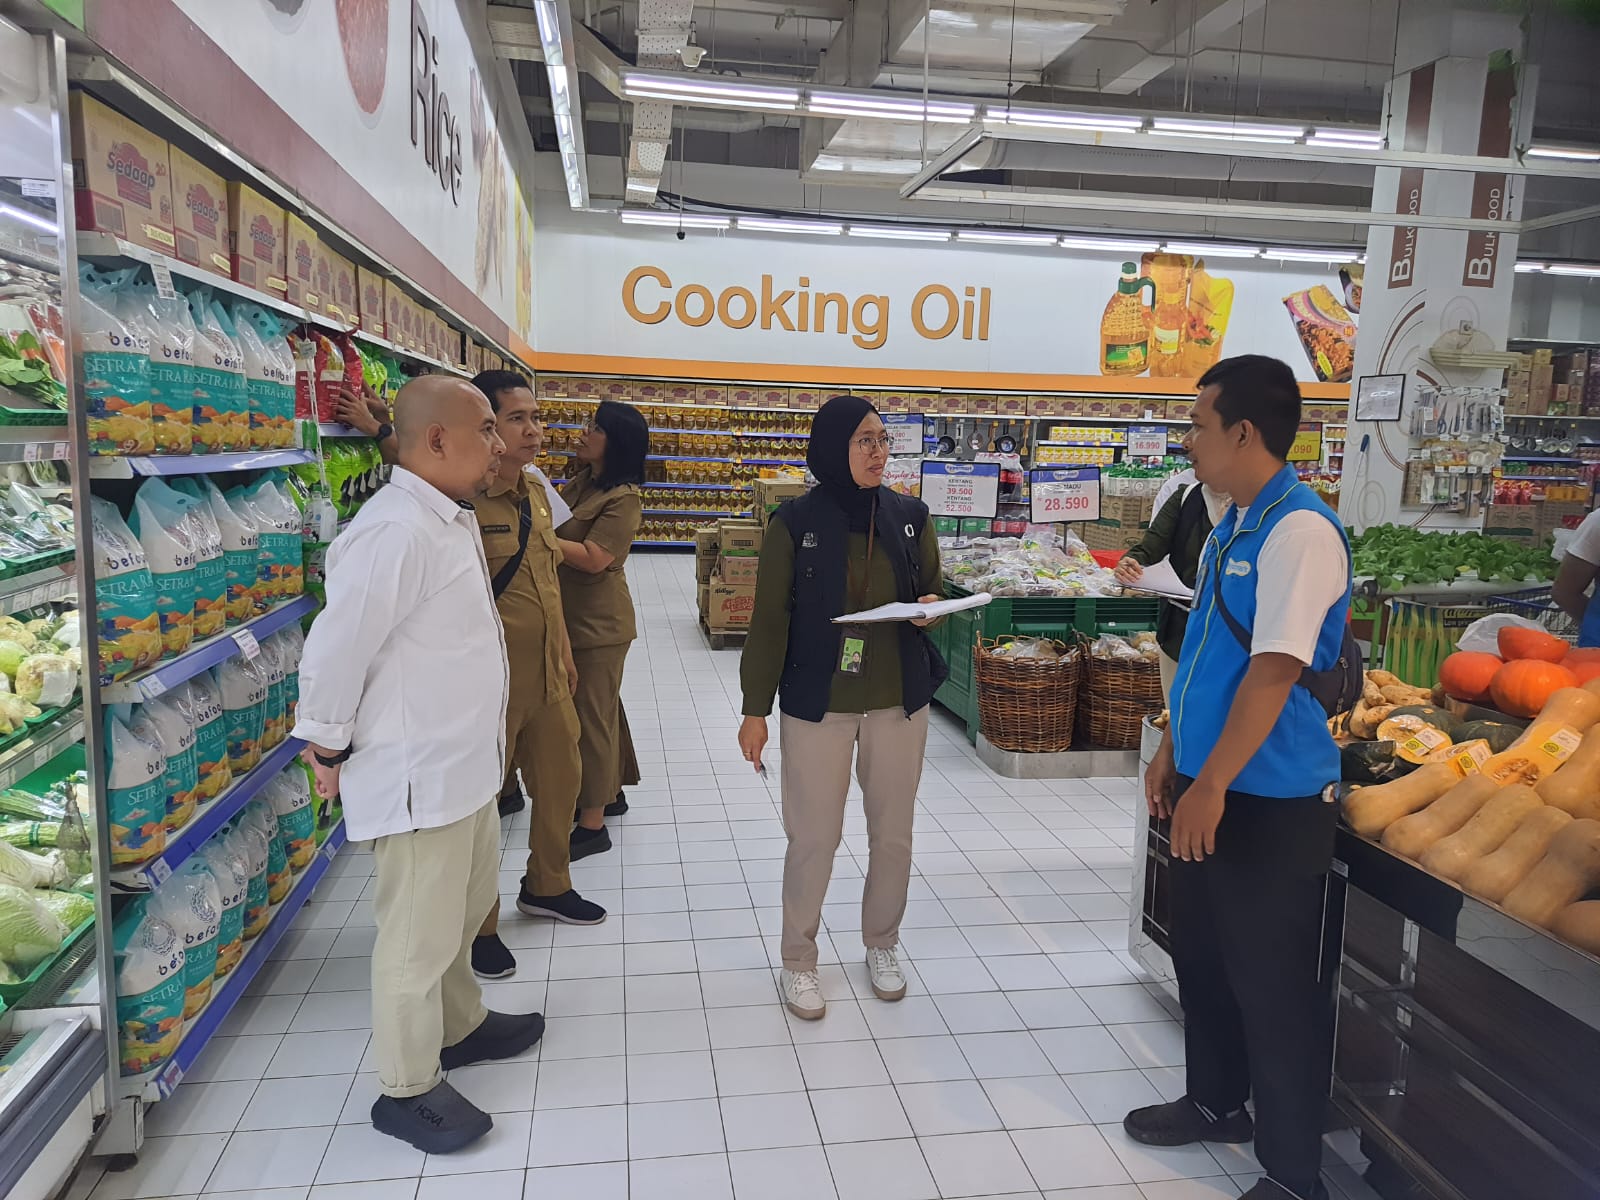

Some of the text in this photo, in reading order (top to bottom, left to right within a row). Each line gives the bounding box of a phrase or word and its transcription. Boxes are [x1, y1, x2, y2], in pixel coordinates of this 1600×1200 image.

[411, 0, 462, 207] Rice
[106, 151, 156, 190] Sedaap
[186, 192, 219, 222] Sedaap
[622, 265, 991, 350] Cooking Oil
[946, 487, 973, 495] 39.500
[1044, 496, 1089, 511] 28.590
